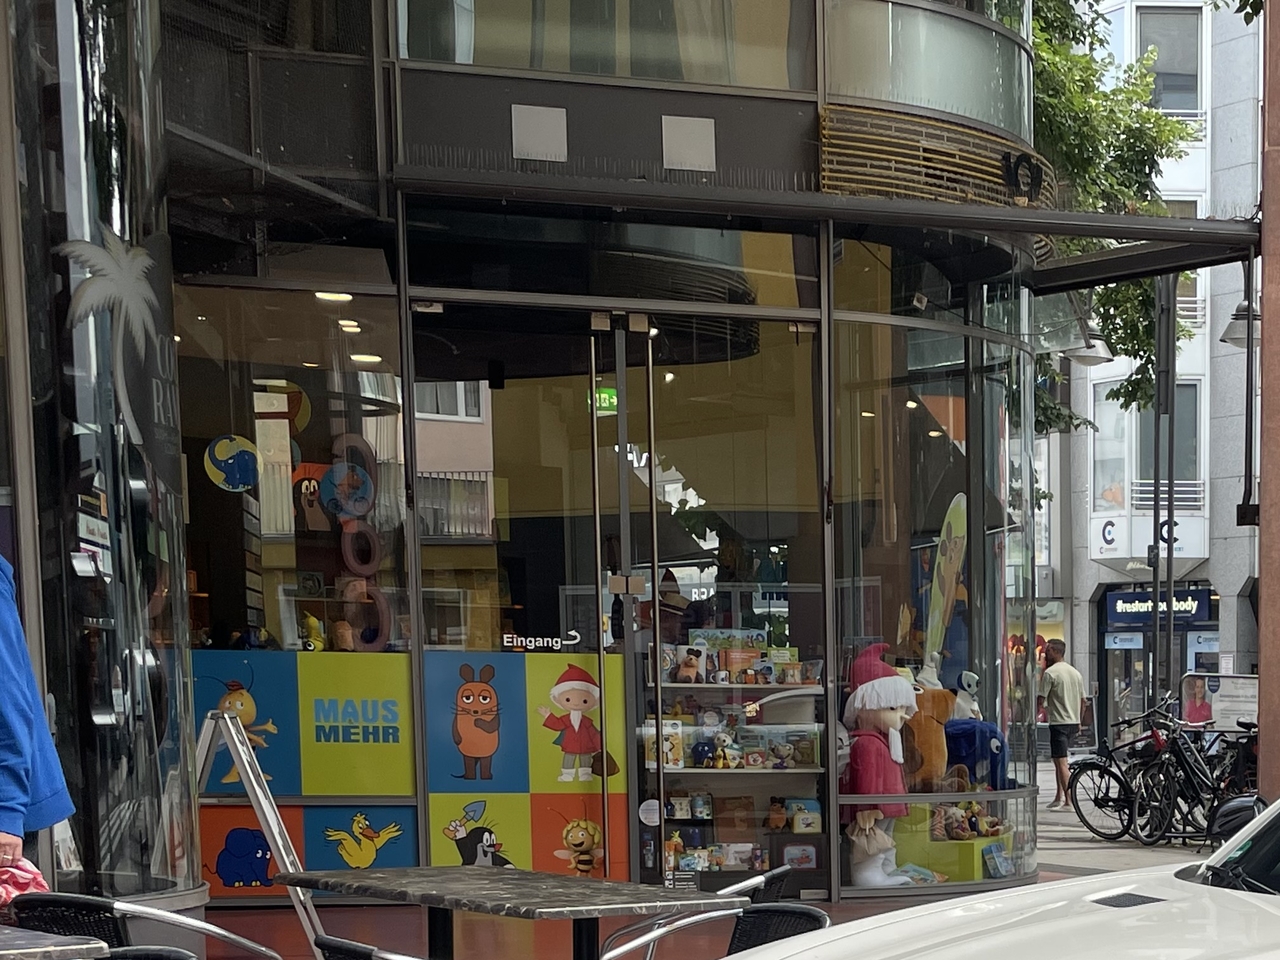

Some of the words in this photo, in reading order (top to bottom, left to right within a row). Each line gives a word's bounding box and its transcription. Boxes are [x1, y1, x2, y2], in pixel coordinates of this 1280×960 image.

[503, 634, 562, 650] Eingang
[314, 698, 399, 724] MAUS
[315, 725, 400, 743] MEHR
